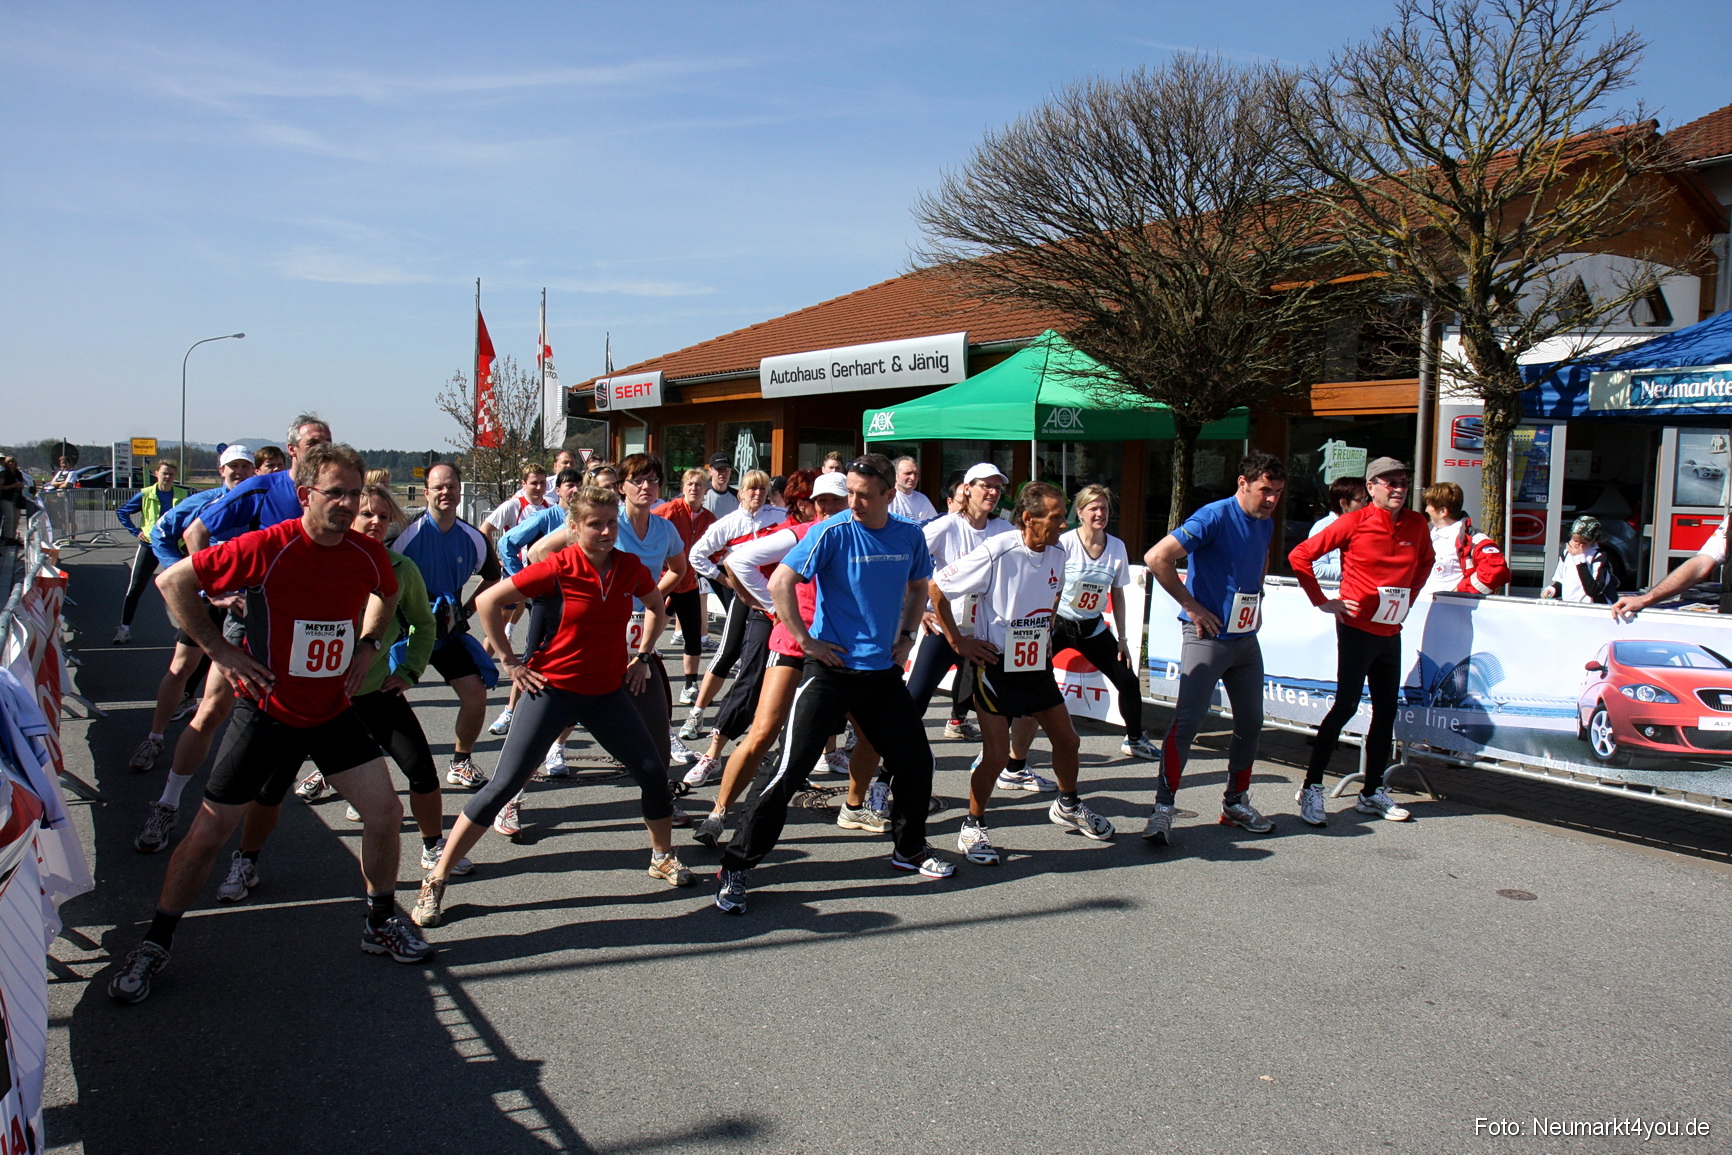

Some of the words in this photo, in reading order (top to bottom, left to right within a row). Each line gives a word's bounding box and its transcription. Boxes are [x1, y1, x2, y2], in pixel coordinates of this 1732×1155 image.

[770, 367, 826, 385] Autohaus
[831, 358, 886, 378] Gerhart
[892, 355, 903, 372] &
[908, 350, 950, 373] Jänig
[615, 382, 653, 399] SEAT
[868, 411, 896, 431] AOK
[1043, 407, 1084, 428] AOK
[734, 446, 753, 468] FOR
[1443, 459, 1484, 467] SEA
[1077, 591, 1100, 610] 93
[305, 623, 335, 632] MEYER
[1237, 605, 1257, 629] 94
[305, 638, 344, 672] 98
[1013, 641, 1039, 668] 58
[1425, 708, 1466, 733] line.
